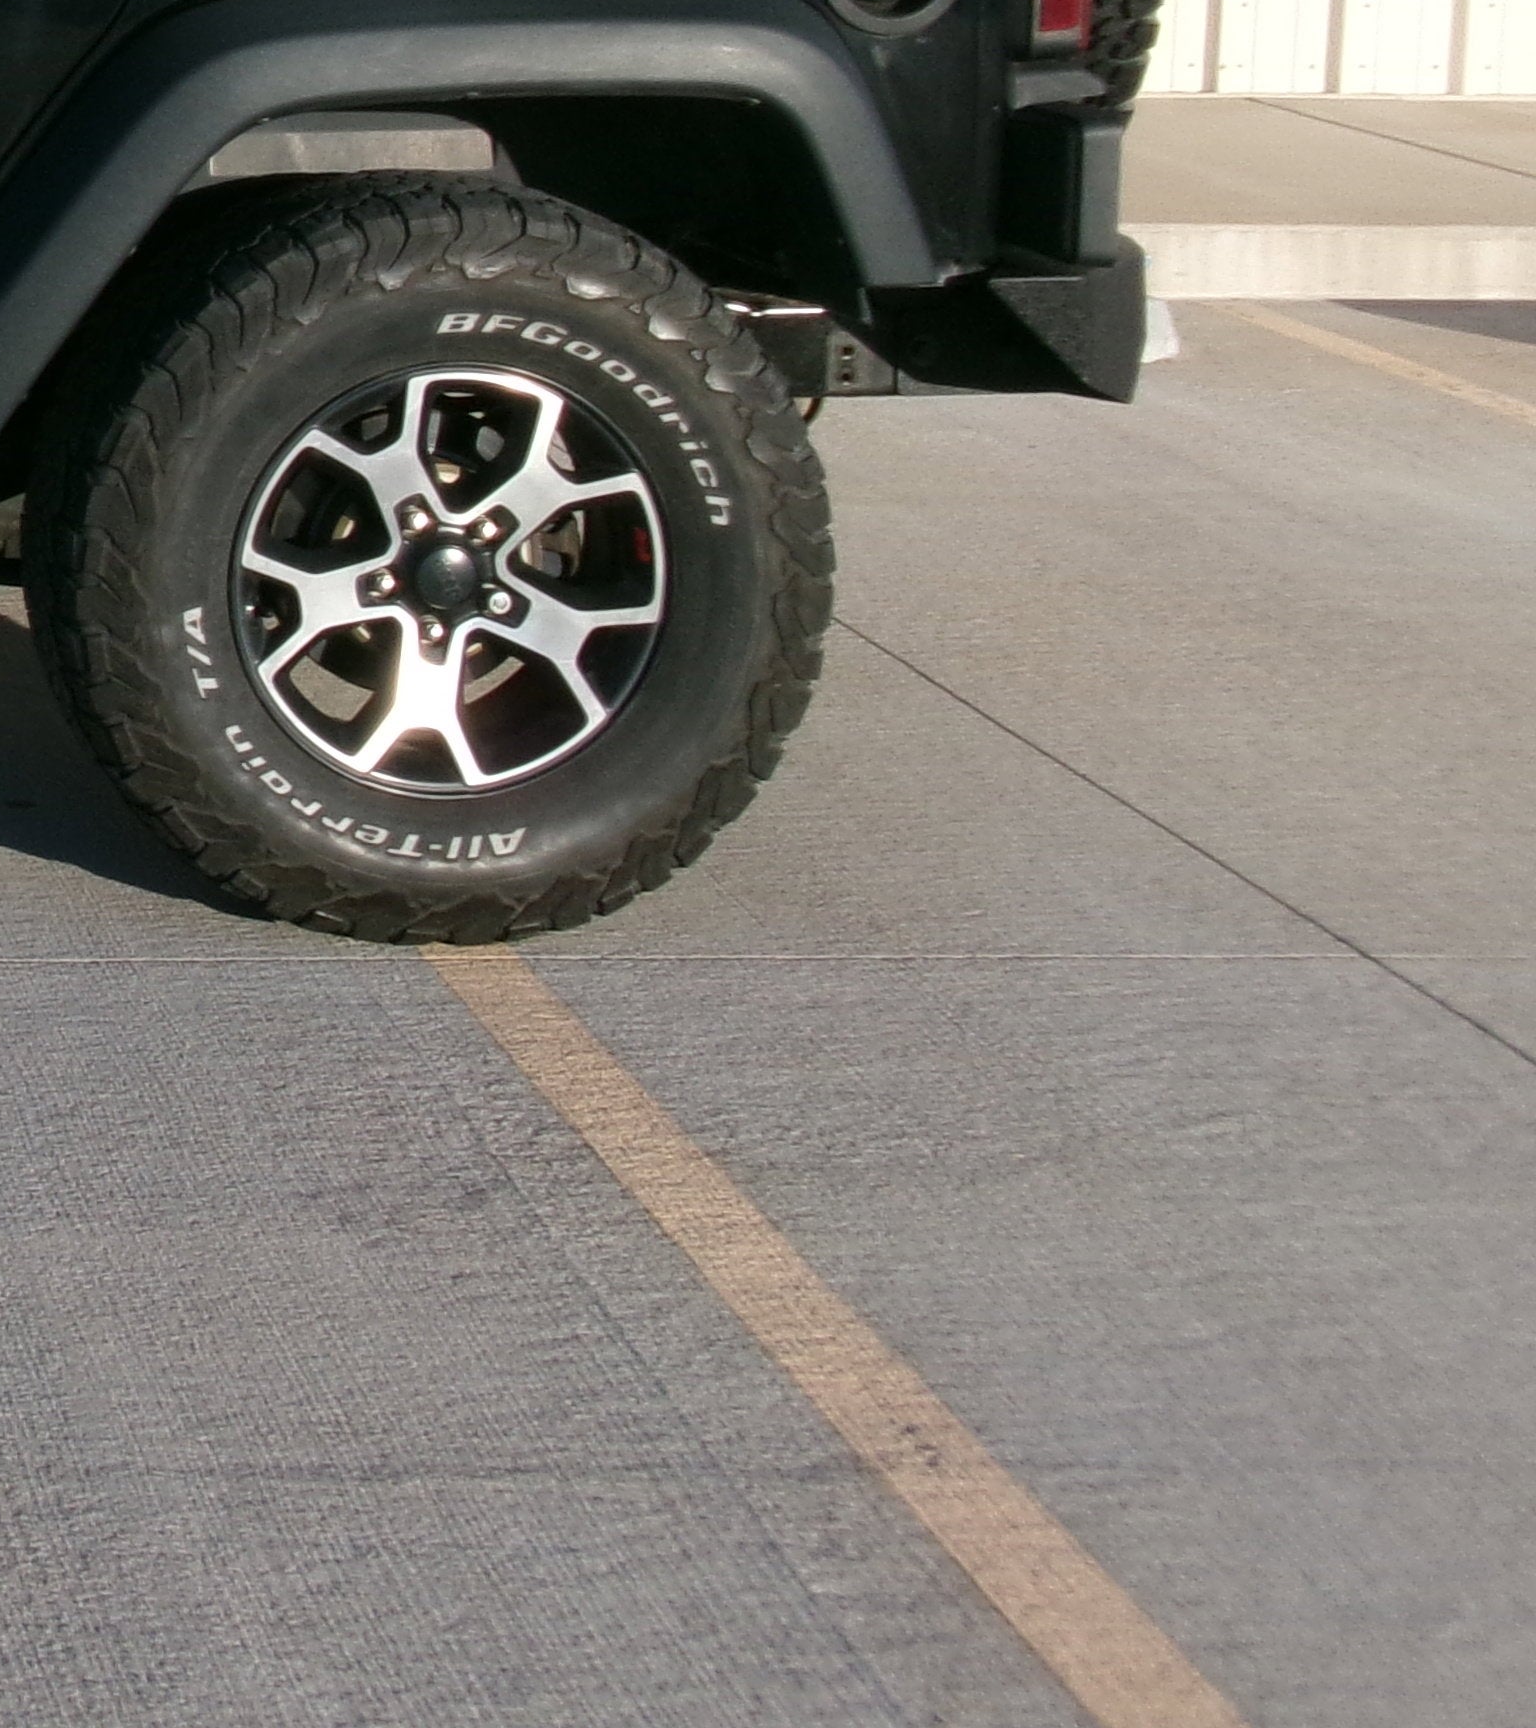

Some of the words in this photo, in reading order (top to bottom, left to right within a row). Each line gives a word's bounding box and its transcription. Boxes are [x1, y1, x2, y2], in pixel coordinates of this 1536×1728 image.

[436, 311, 732, 526] BFGoodrich
[181, 604, 221, 700] T/A
[225, 724, 527, 860] All-Terrain
